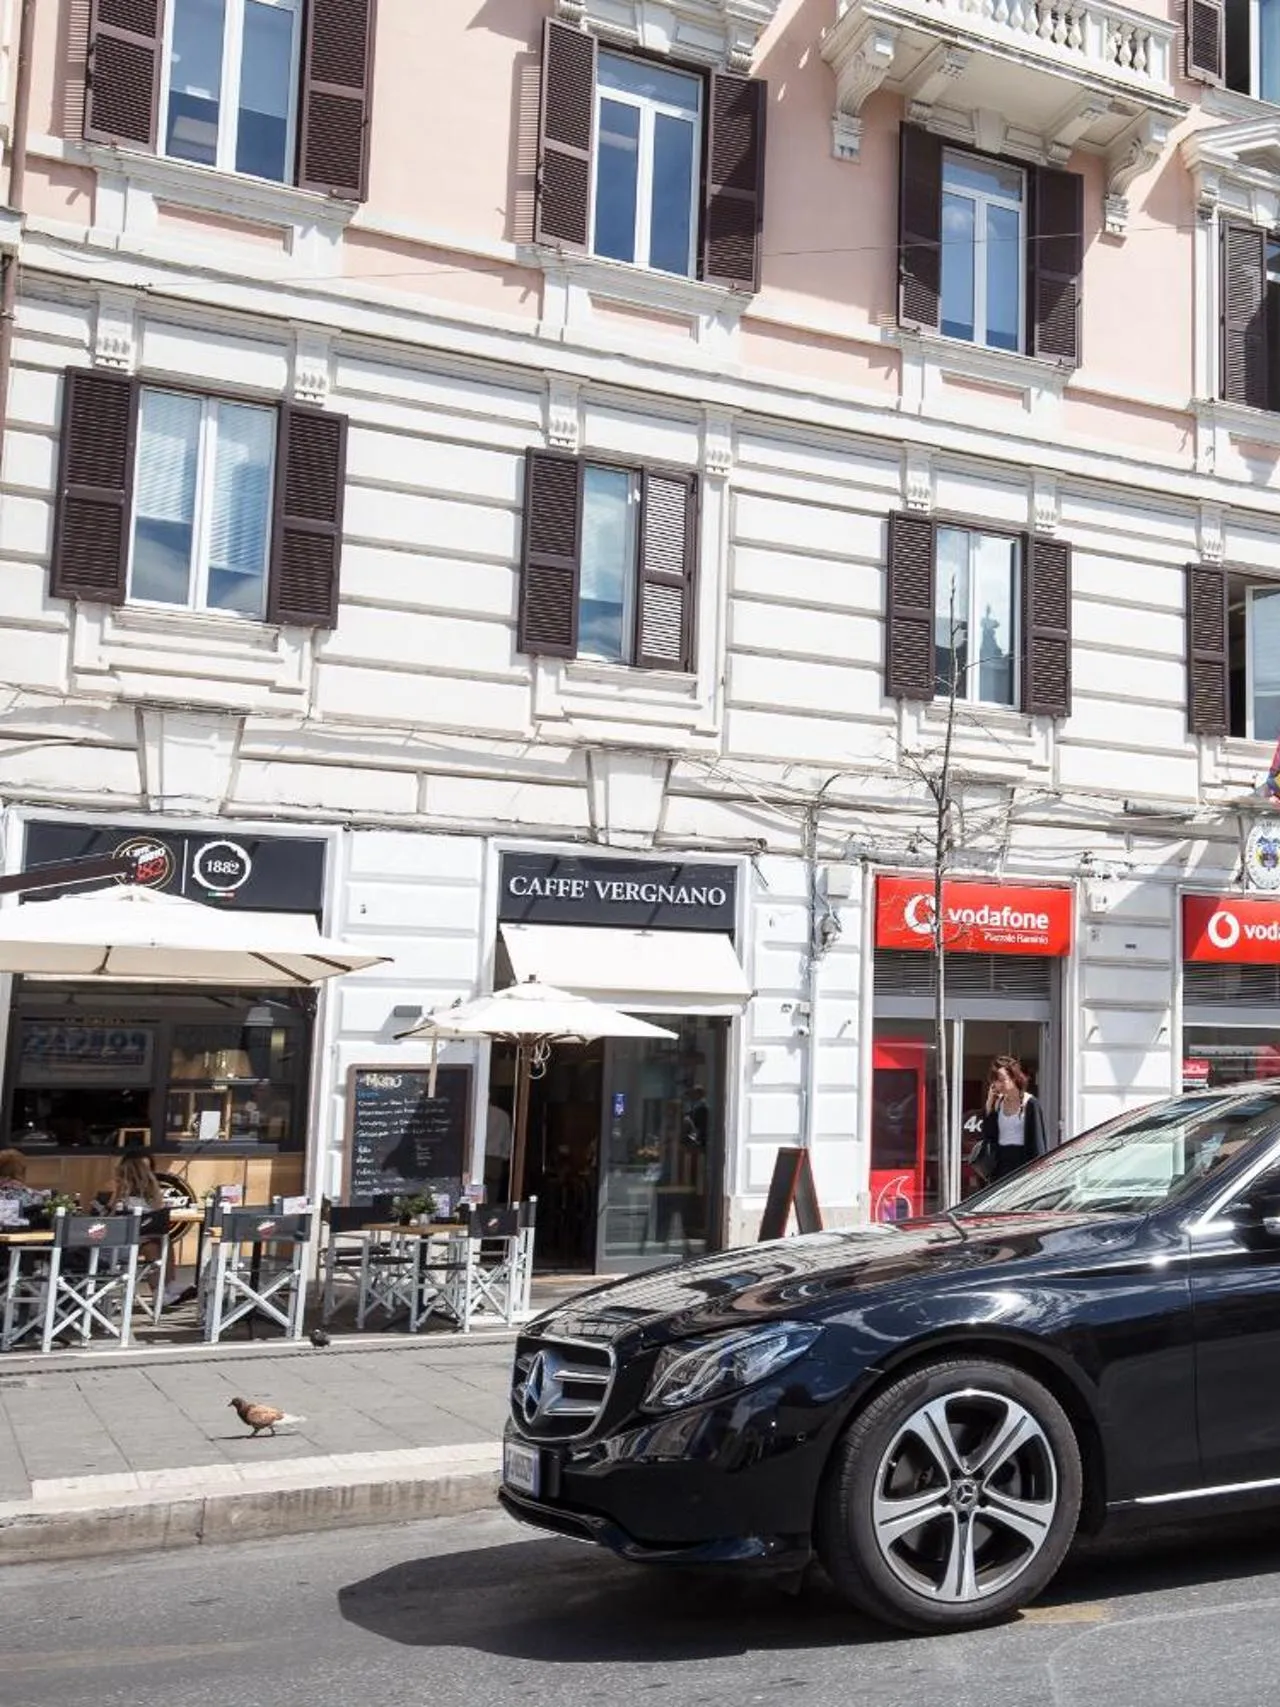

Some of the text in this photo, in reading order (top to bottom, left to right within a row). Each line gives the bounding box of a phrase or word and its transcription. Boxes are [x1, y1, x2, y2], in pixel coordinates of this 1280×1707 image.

[206, 860, 240, 874] 1882
[509, 876, 727, 906] CAFFE' VERGNANO
[948, 905, 1049, 929] vodafone
